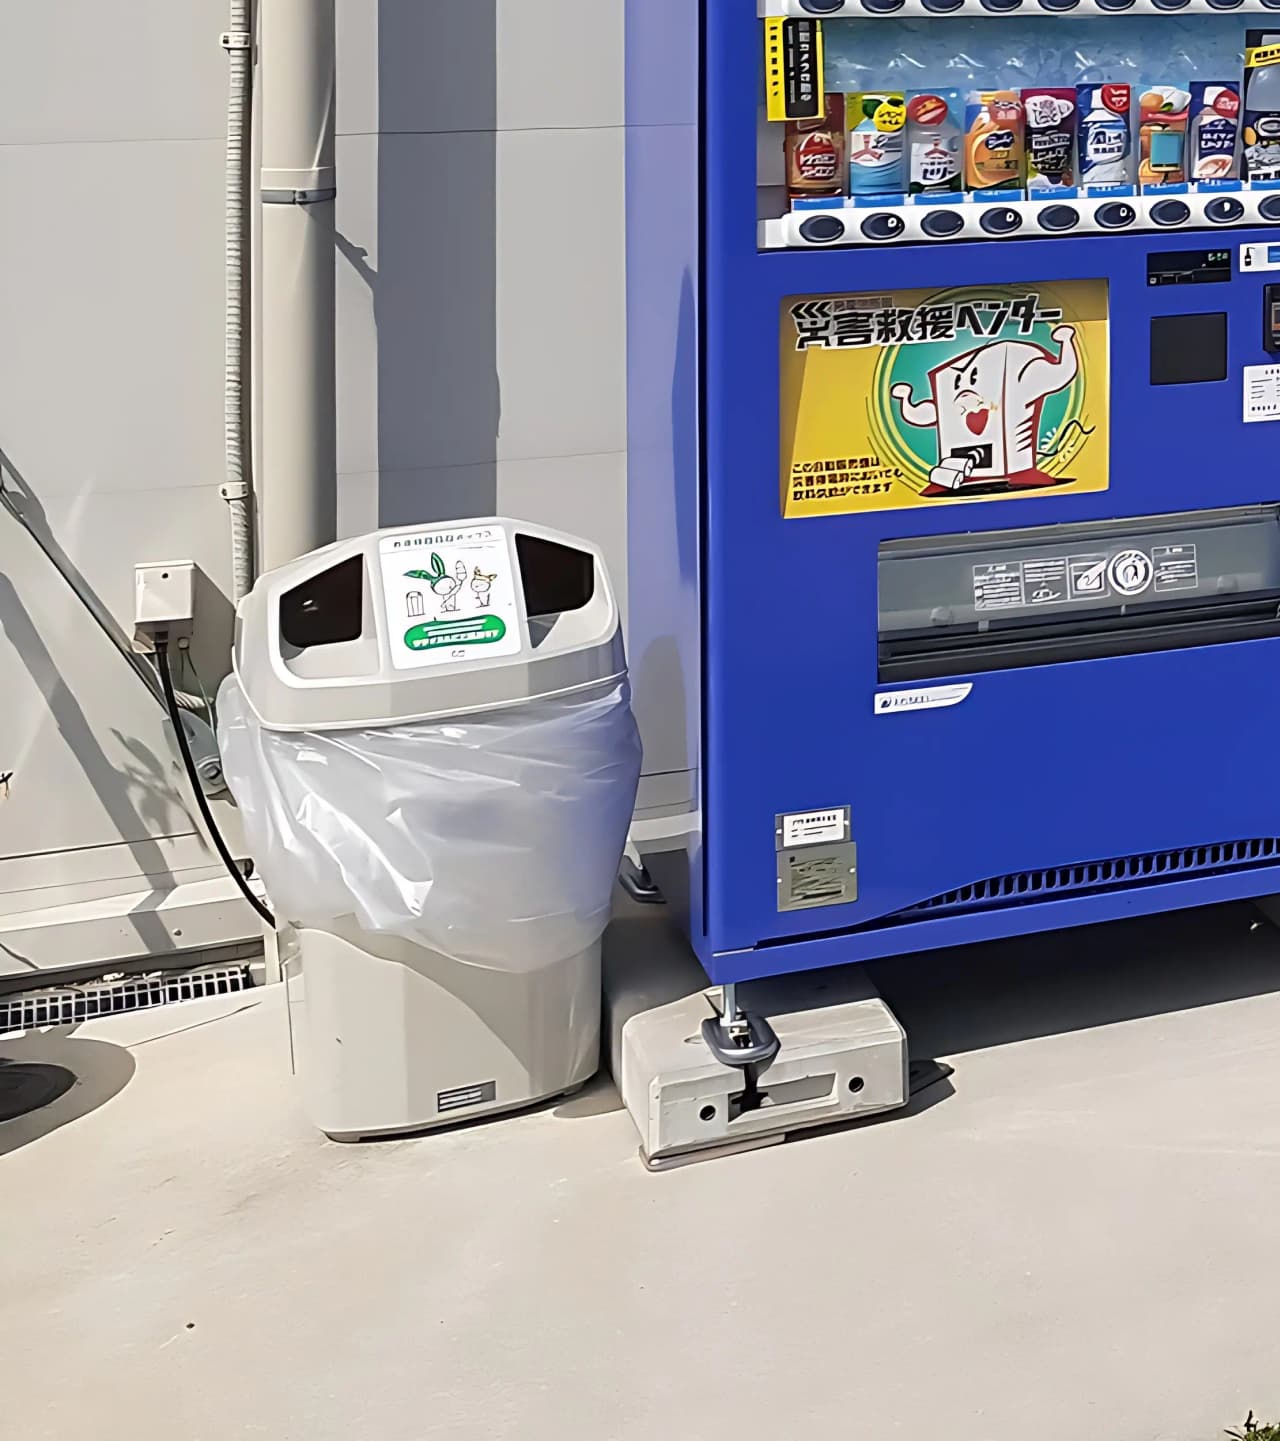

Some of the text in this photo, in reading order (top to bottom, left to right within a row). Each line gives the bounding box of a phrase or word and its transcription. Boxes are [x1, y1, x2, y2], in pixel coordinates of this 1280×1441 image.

[794, 294, 1063, 350] 災害救援ベンダー
